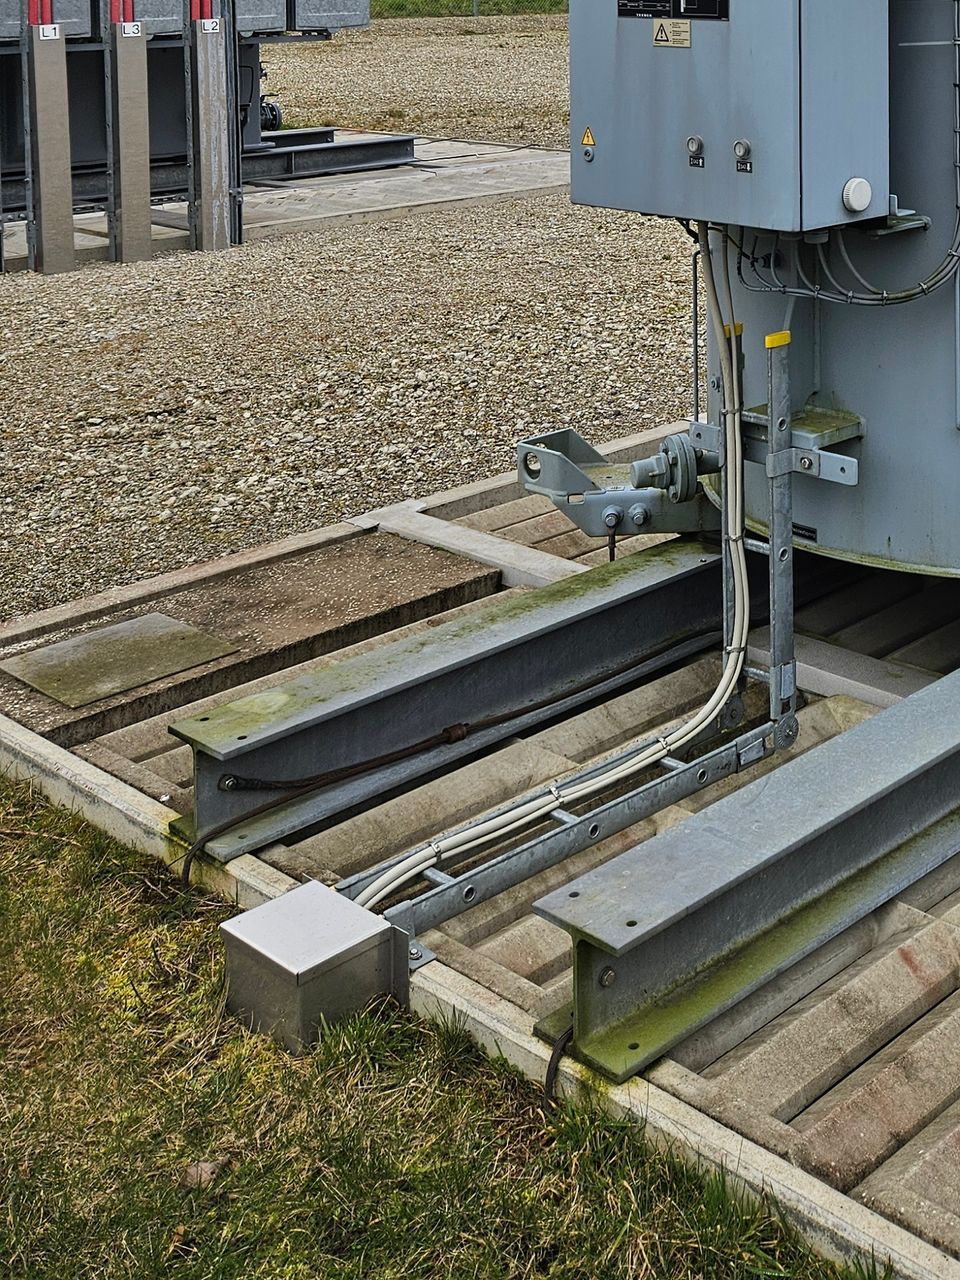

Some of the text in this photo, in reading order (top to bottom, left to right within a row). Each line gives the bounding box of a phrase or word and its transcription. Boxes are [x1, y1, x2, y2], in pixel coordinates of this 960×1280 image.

[123, 25, 140, 34] L3
[203, 21, 218, 31] L2
[42, 27, 57, 37] L1
